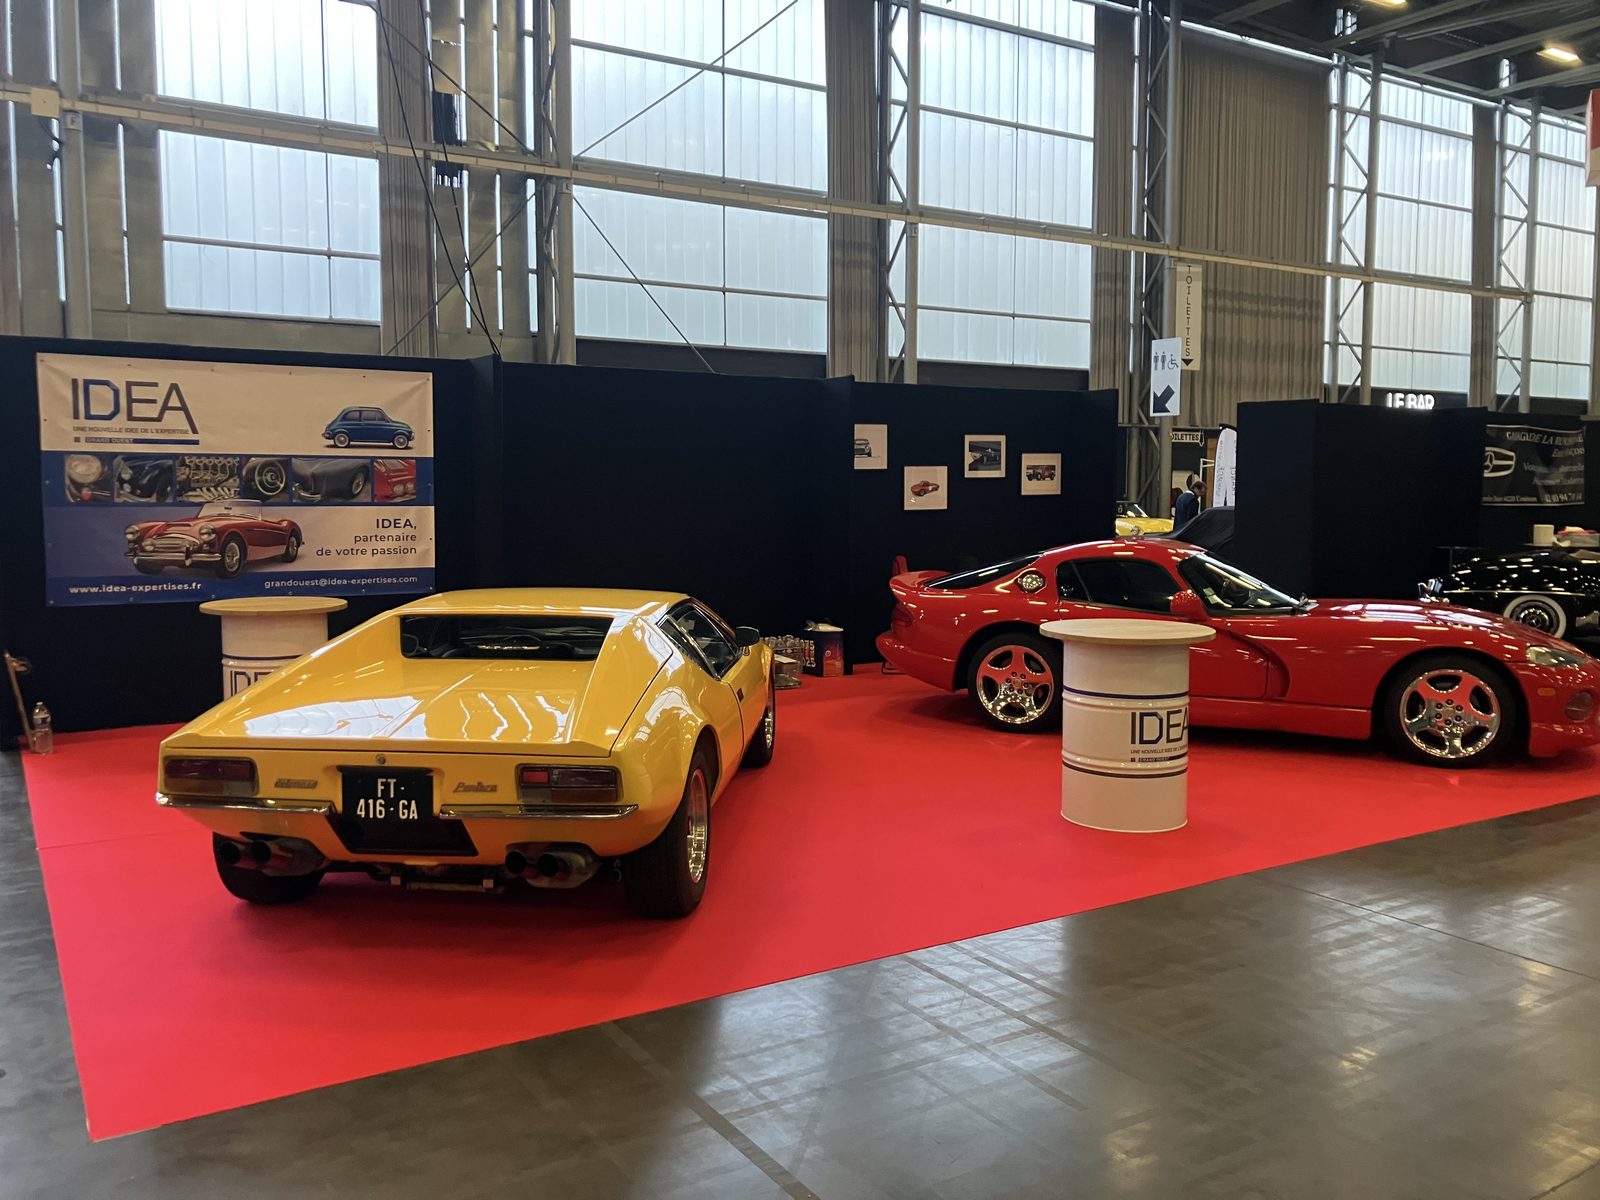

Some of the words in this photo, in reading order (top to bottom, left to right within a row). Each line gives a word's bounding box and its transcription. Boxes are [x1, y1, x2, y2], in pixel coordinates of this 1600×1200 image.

[1184, 265, 1193, 357] TOILETTES
[71, 378, 199, 434] IDEA
[376, 518, 417, 530] IDEA,
[354, 533, 417, 544] partenaire
[316, 547, 332, 557] de
[335, 547, 368, 556] votre
[371, 546, 417, 557] passion
[69, 581, 202, 594] www.idea-expertises.fr
[264, 576, 418, 589] grandouest@idea-expertises.com
[377, 778, 397, 798] FT
